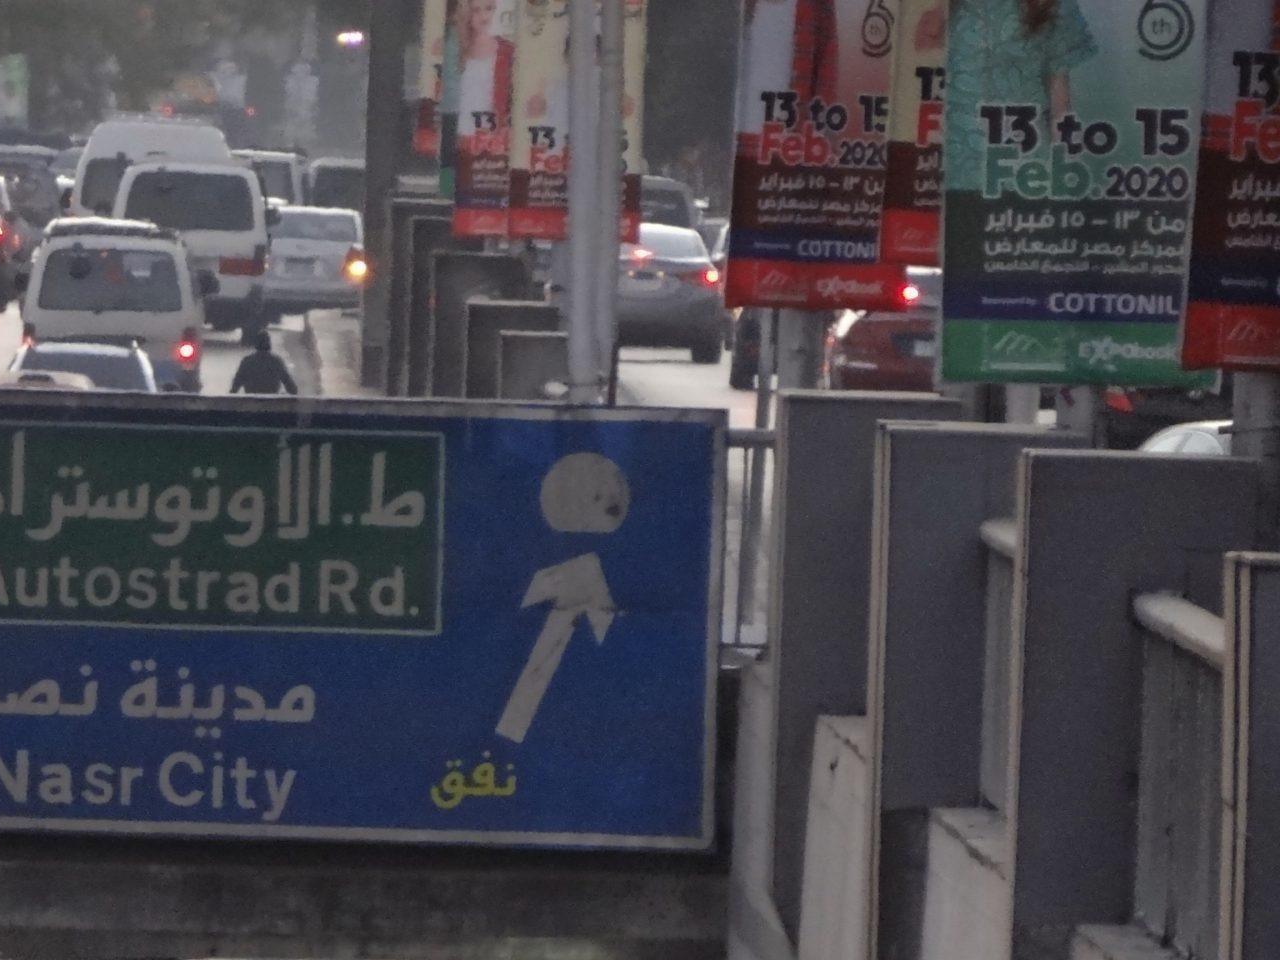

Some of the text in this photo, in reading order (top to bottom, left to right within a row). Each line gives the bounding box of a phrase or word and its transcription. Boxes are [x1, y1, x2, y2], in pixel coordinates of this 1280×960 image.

[761, 91, 797, 128] 13
[810, 98, 848, 131] to
[979, 105, 1038, 153] 13
[1056, 114, 1118, 155] to
[1135, 108, 1191, 156] 15
[758, 121, 837, 166] Feb.
[983, 144, 1190, 199] Feb. 2020
[984, 207, 1055, 233] فبراير
[1061, 209, 1085, 229] ١٥
[1114, 209, 1141, 229] ١٣
[1147, 210, 1186, 235] من
[983, 236, 1078, 257] للمعارض
[1080, 241, 1125, 258] مصر
[1048, 292, 1179, 315] COTTONIL
[317, 558, 421, 618] Rd.
[119, 659, 318, 739] مدينة
[157, 751, 297, 821] City
[430, 749, 518, 809] نفق
